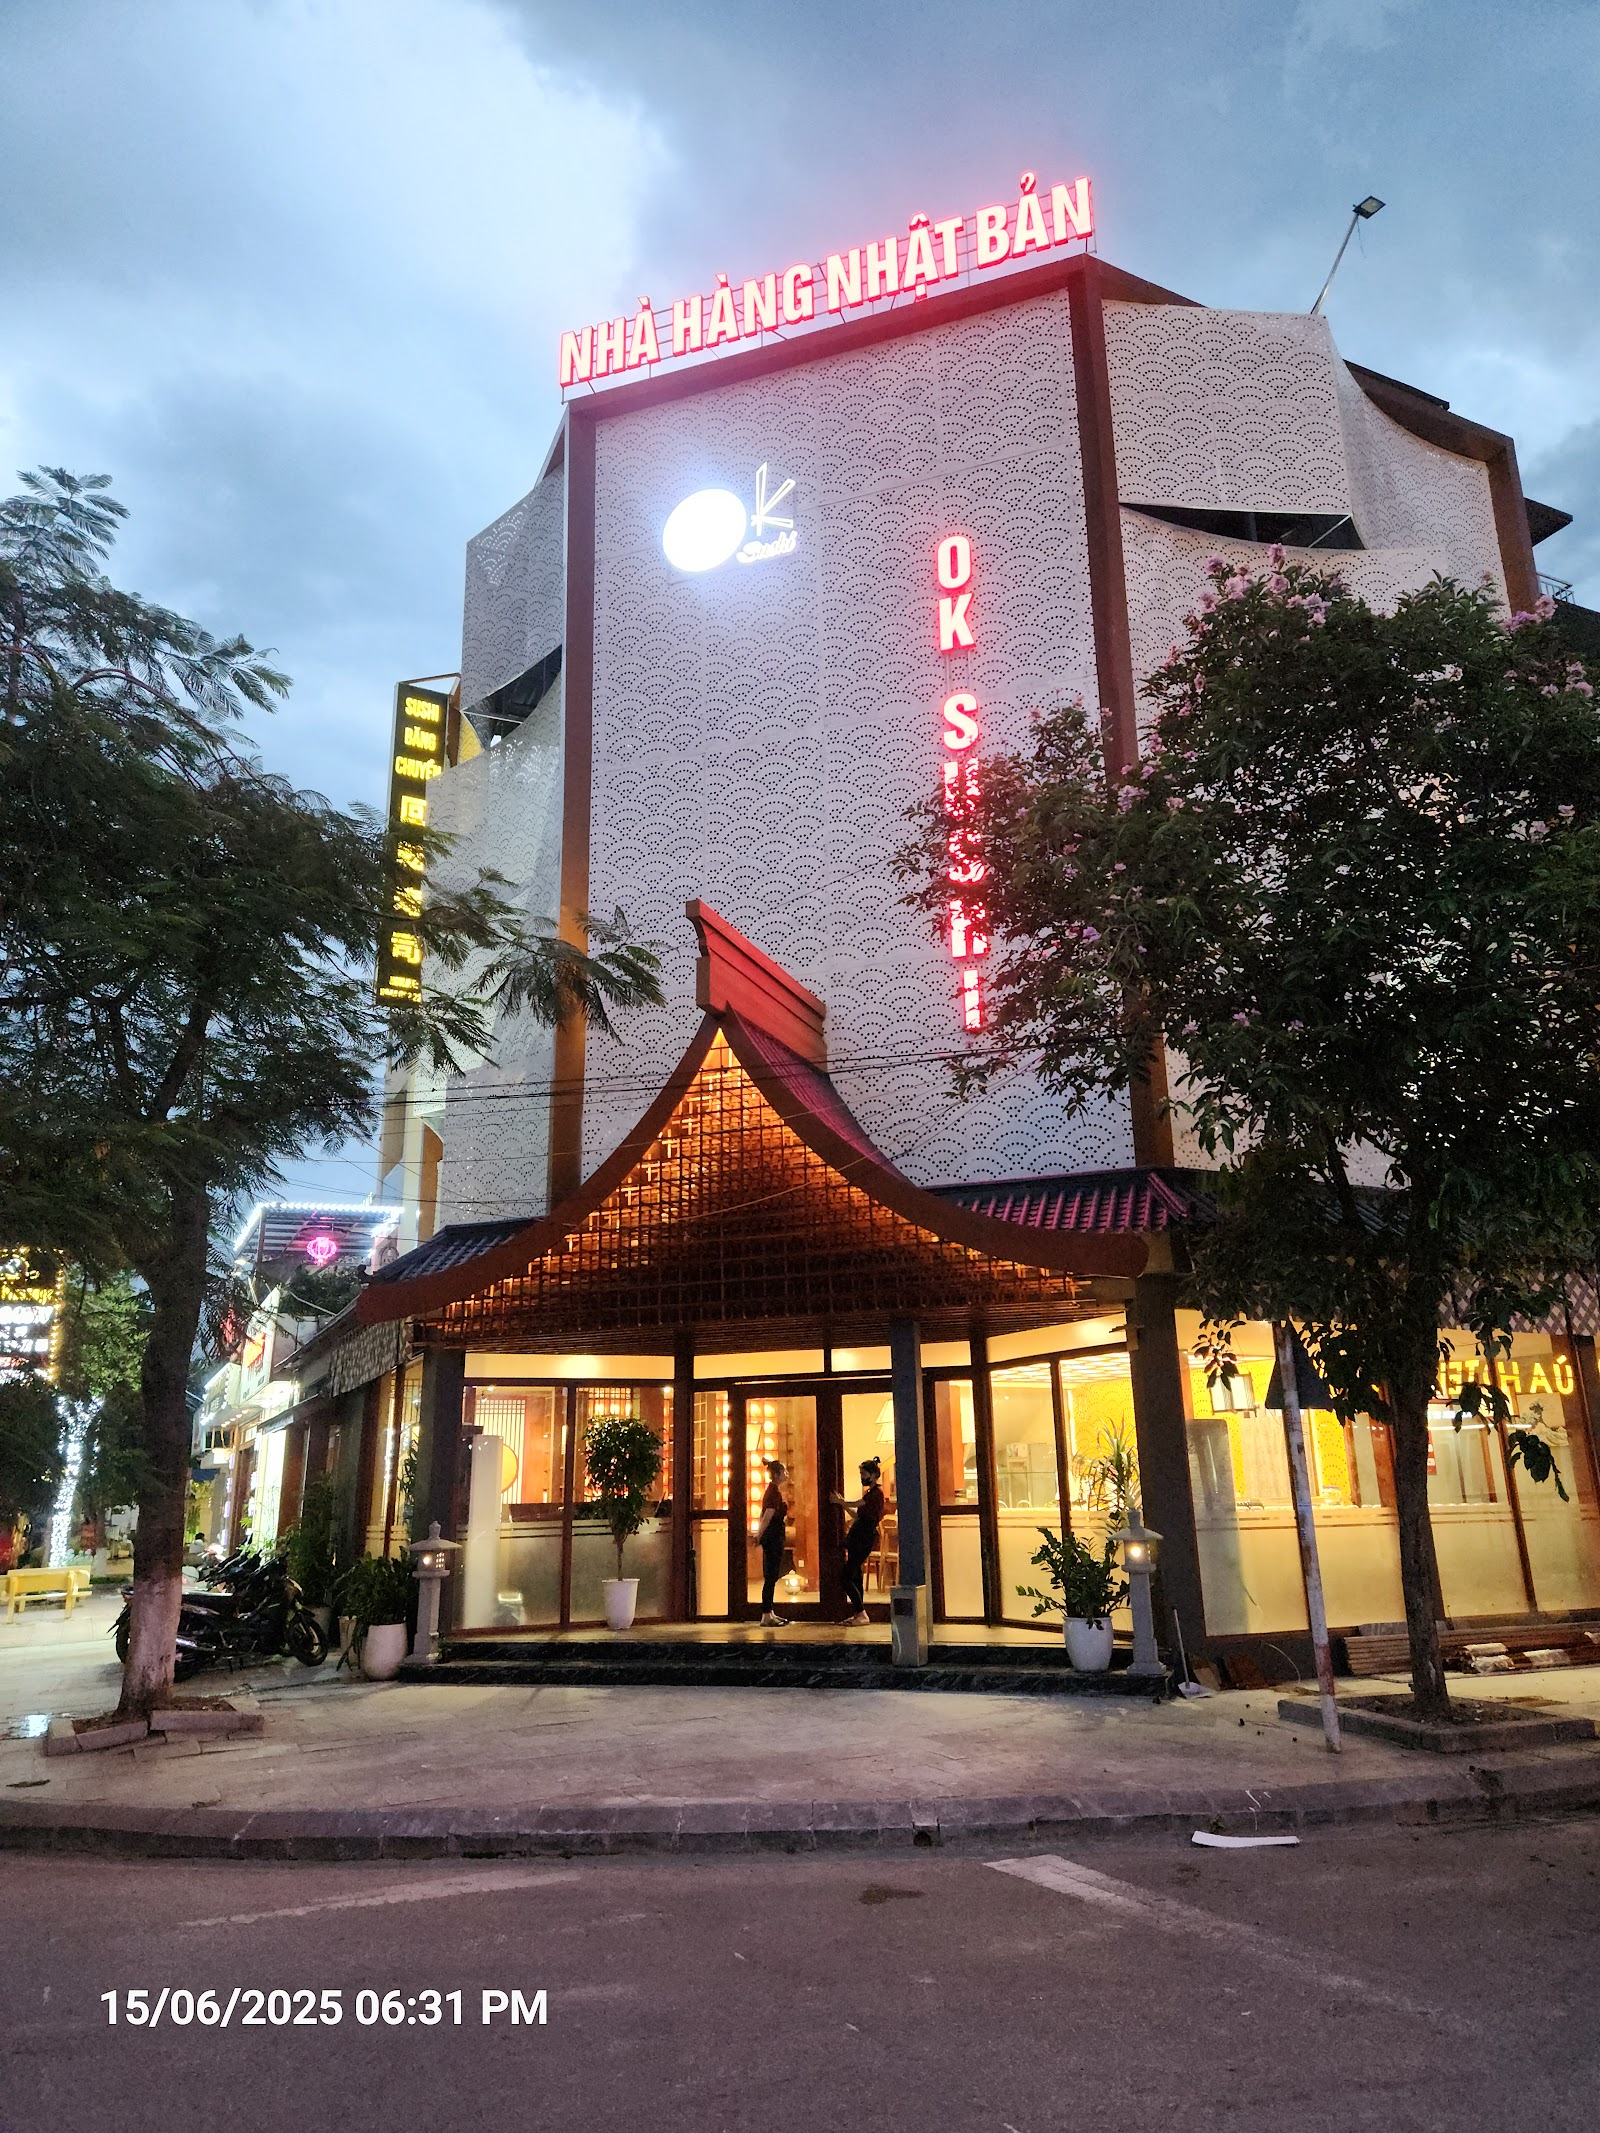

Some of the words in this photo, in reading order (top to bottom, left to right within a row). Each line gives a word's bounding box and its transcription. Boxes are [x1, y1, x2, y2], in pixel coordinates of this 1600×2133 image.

[560, 296, 661, 386] NHÀ
[672, 273, 815, 356] HÀNG
[825, 212, 964, 314] NHẬT
[976, 171, 1094, 269] BẢN
[937, 535, 977, 654] OK
[405, 697, 440, 722] SUSHI
